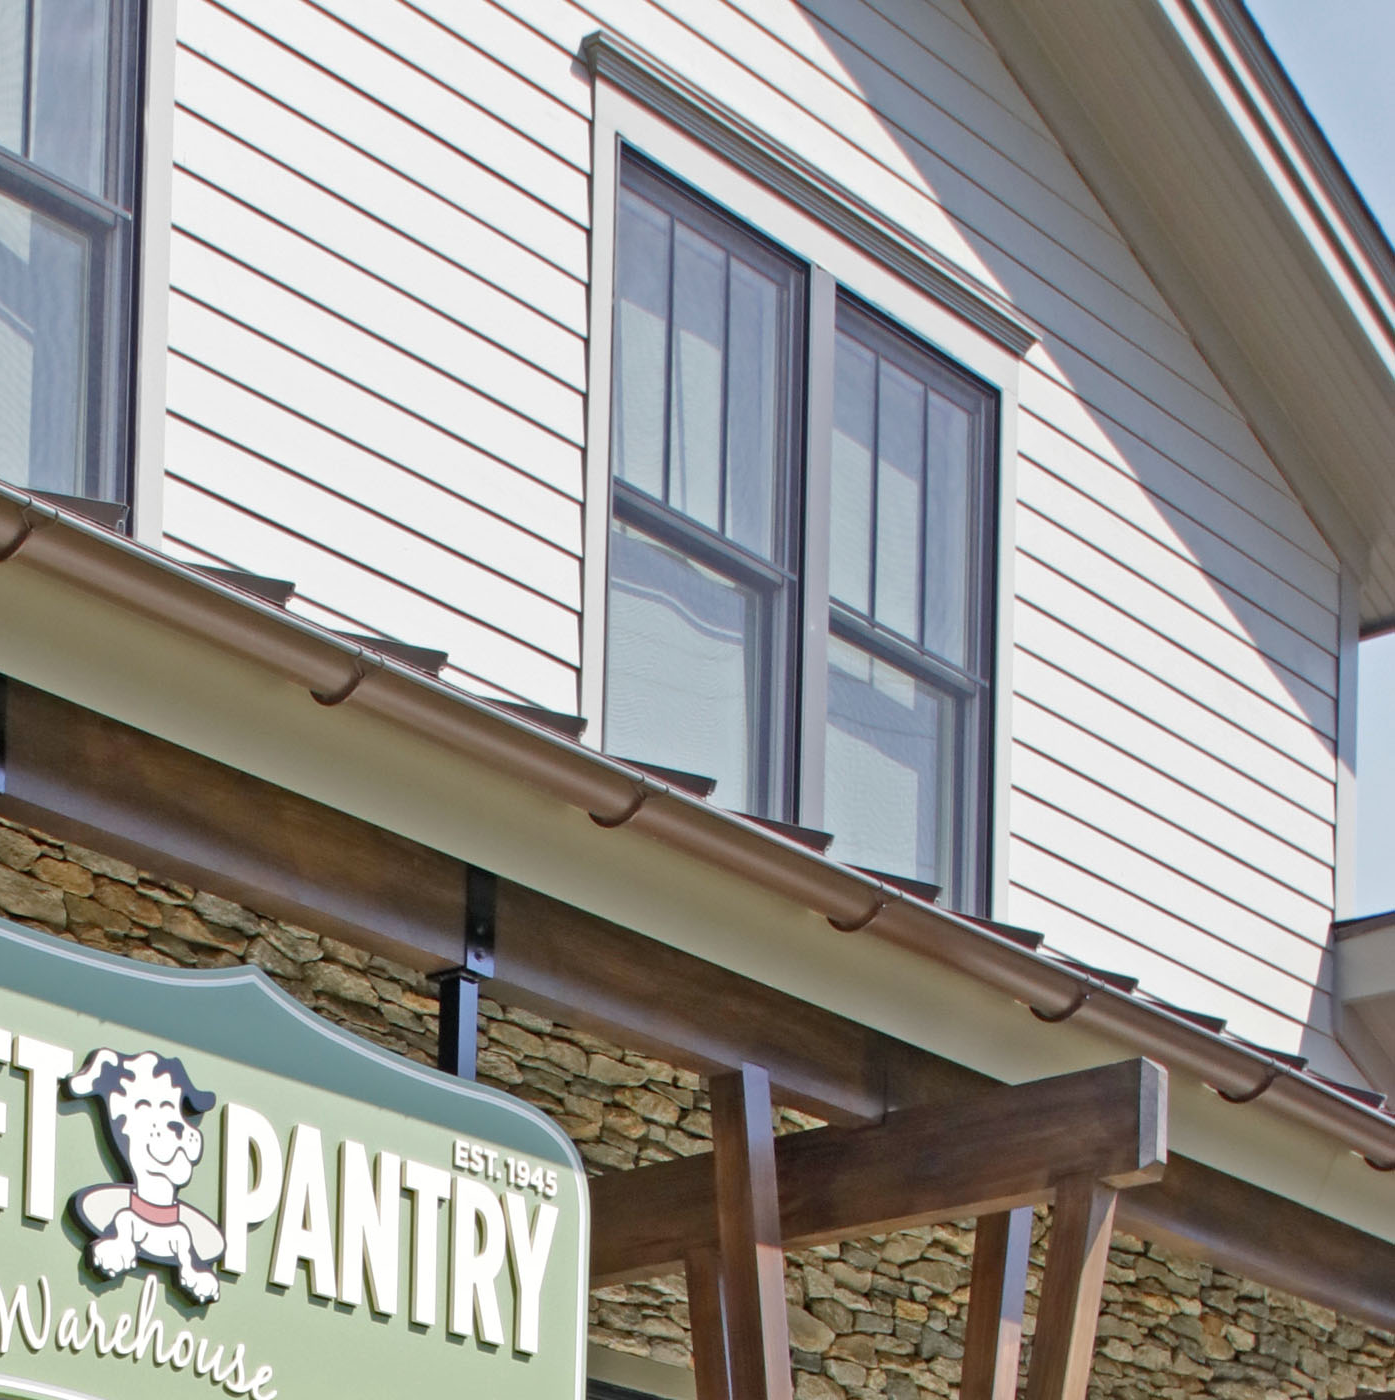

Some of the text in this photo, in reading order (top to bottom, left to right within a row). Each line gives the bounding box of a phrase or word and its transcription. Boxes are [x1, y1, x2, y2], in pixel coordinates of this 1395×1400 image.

[218, 1102, 558, 1354] PANTRY
[453, 1139, 558, 1197] EST. 1945
